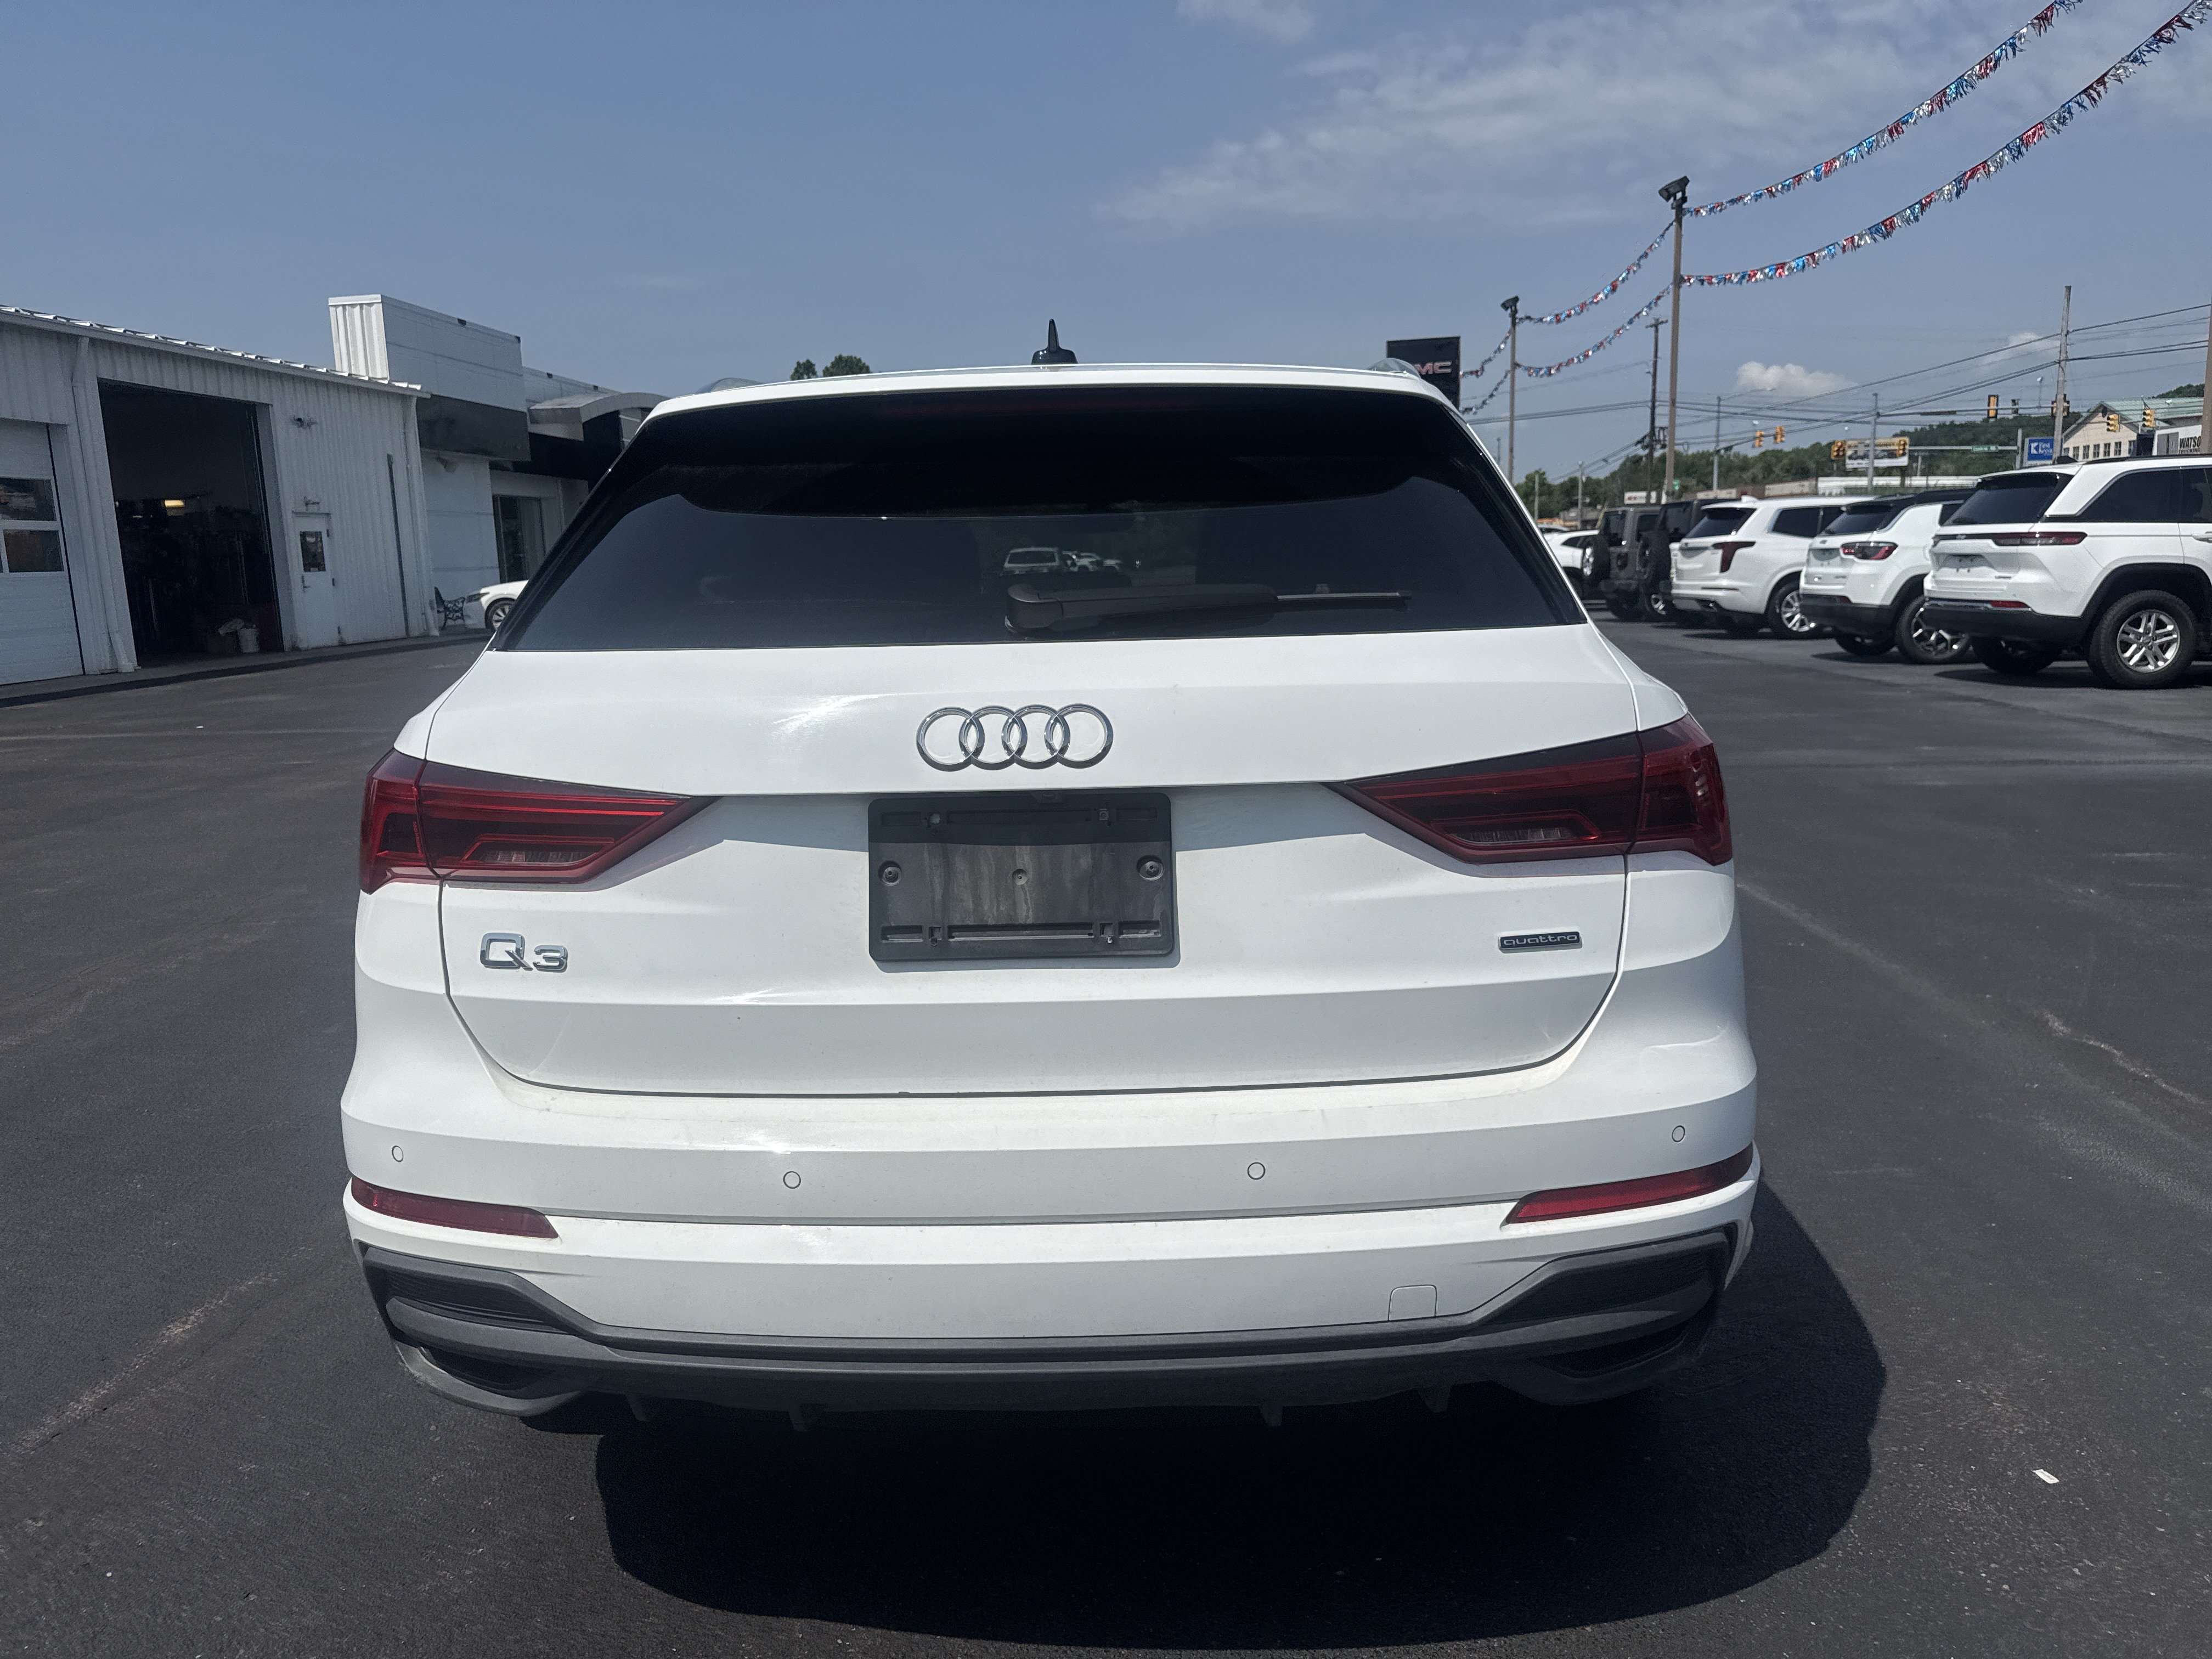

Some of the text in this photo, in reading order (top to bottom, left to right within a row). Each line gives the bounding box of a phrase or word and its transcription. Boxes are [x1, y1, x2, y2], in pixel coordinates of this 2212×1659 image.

[1414, 361, 1452, 375] MC
[2180, 436, 2202, 448] WATSO
[1503, 934, 1578, 946] quattro
[480, 933, 568, 973] Q3
